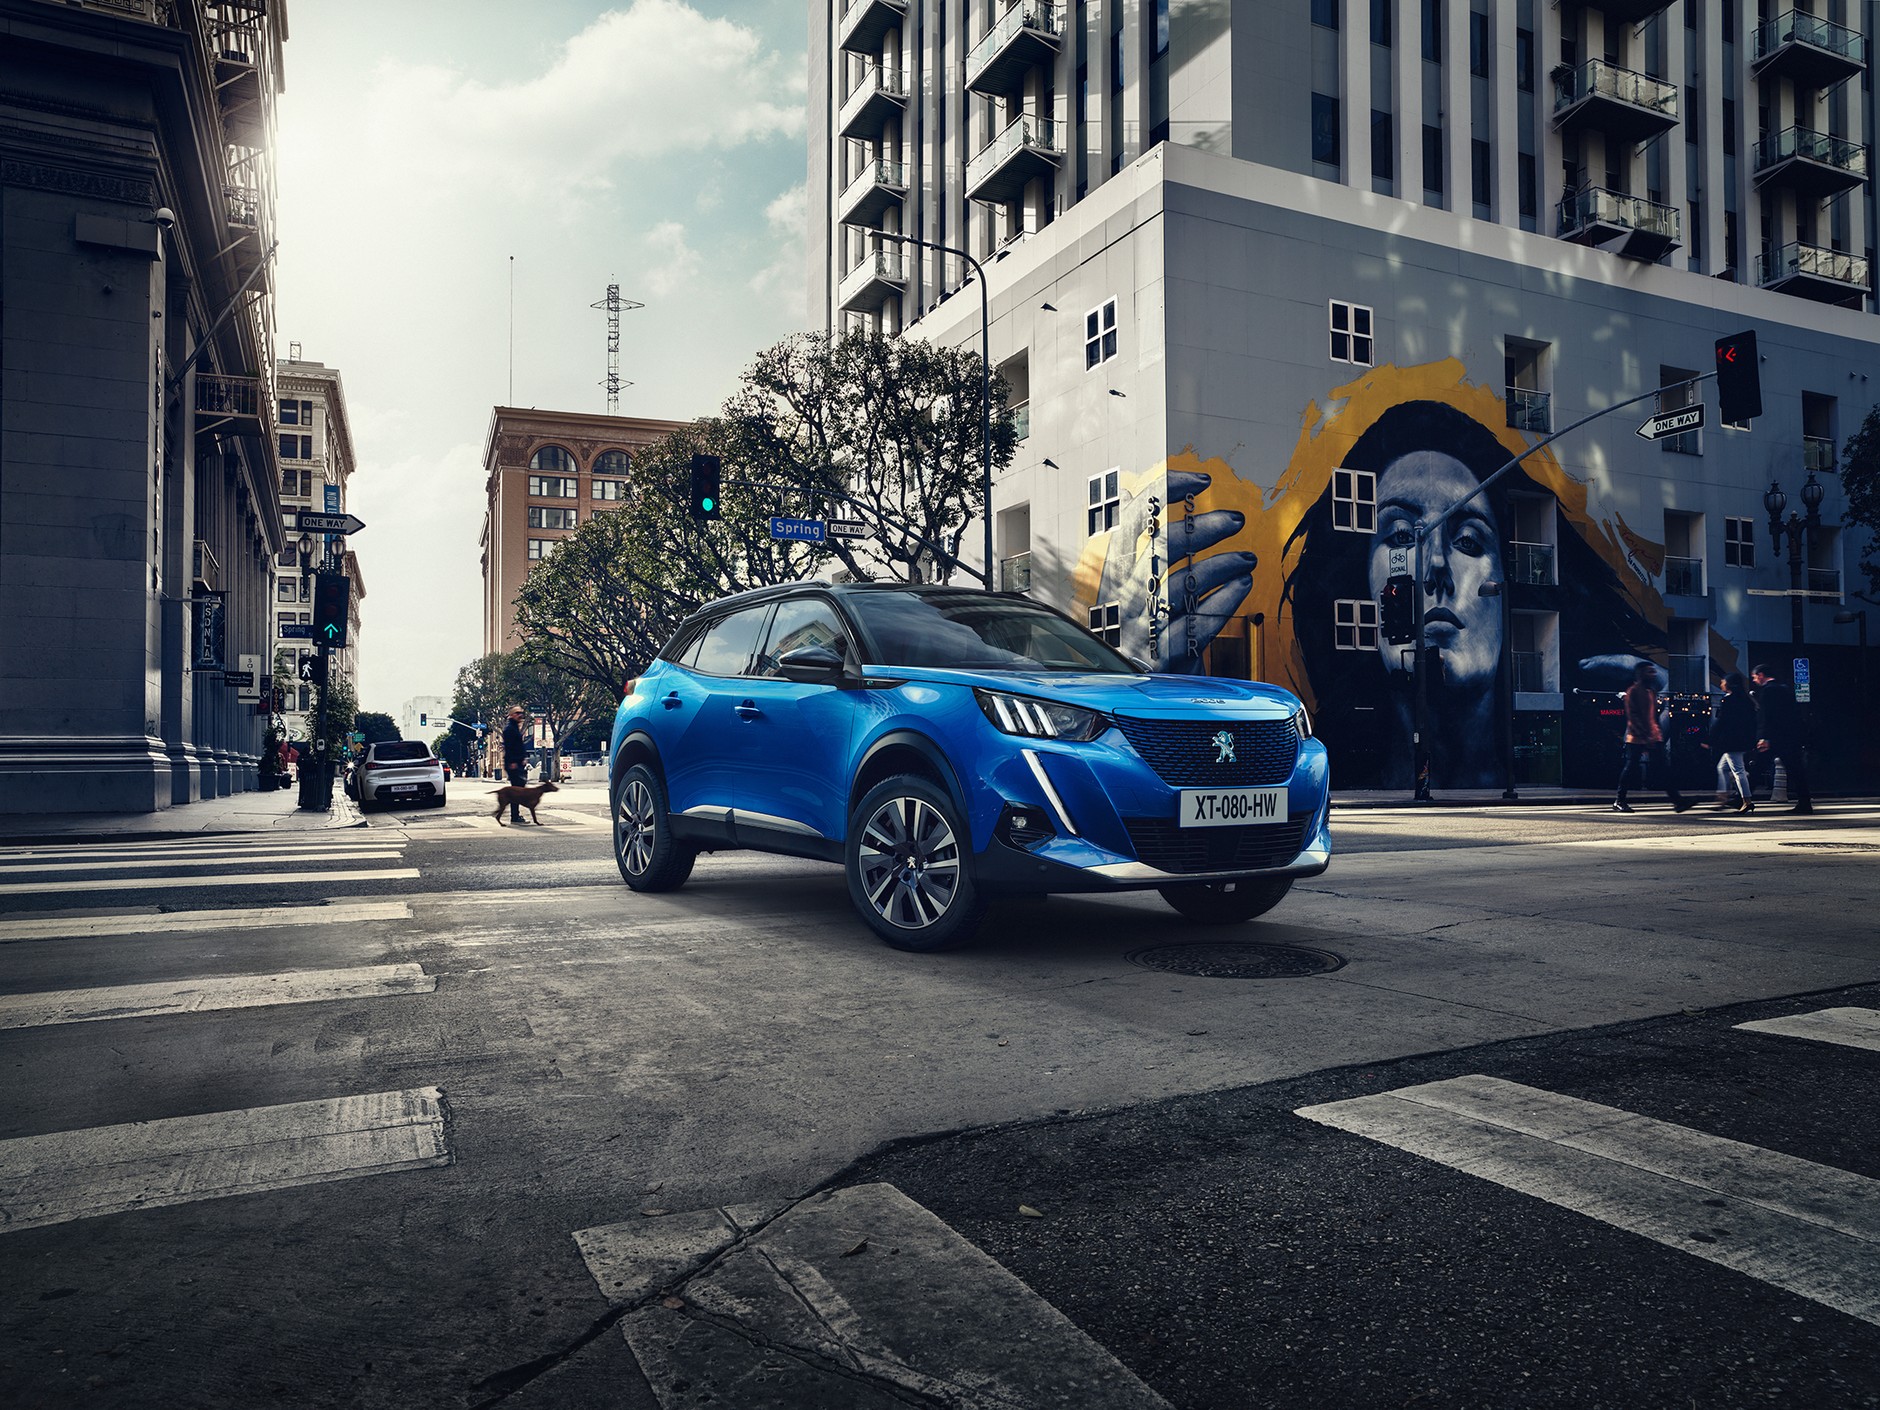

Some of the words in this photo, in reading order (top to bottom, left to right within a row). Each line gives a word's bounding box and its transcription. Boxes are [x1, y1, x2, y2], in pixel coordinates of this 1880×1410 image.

[1655, 418, 1674, 431] ONE
[1677, 412, 1697, 425] WAY
[1147, 496, 1157, 537] SB
[1184, 492, 1196, 534] SB
[304, 518, 323, 527] ONE
[326, 519, 346, 529] WAY
[776, 521, 820, 539] Spring
[832, 524, 848, 533] ONE
[849, 525, 865, 534] WAY
[1391, 565, 1406, 574] SIGNAL
[1146, 555, 1158, 660] TOWER
[1184, 552, 1199, 658] TOWER
[283, 625, 306, 636] Spring
[1195, 793, 1278, 819] XT-080-HW
